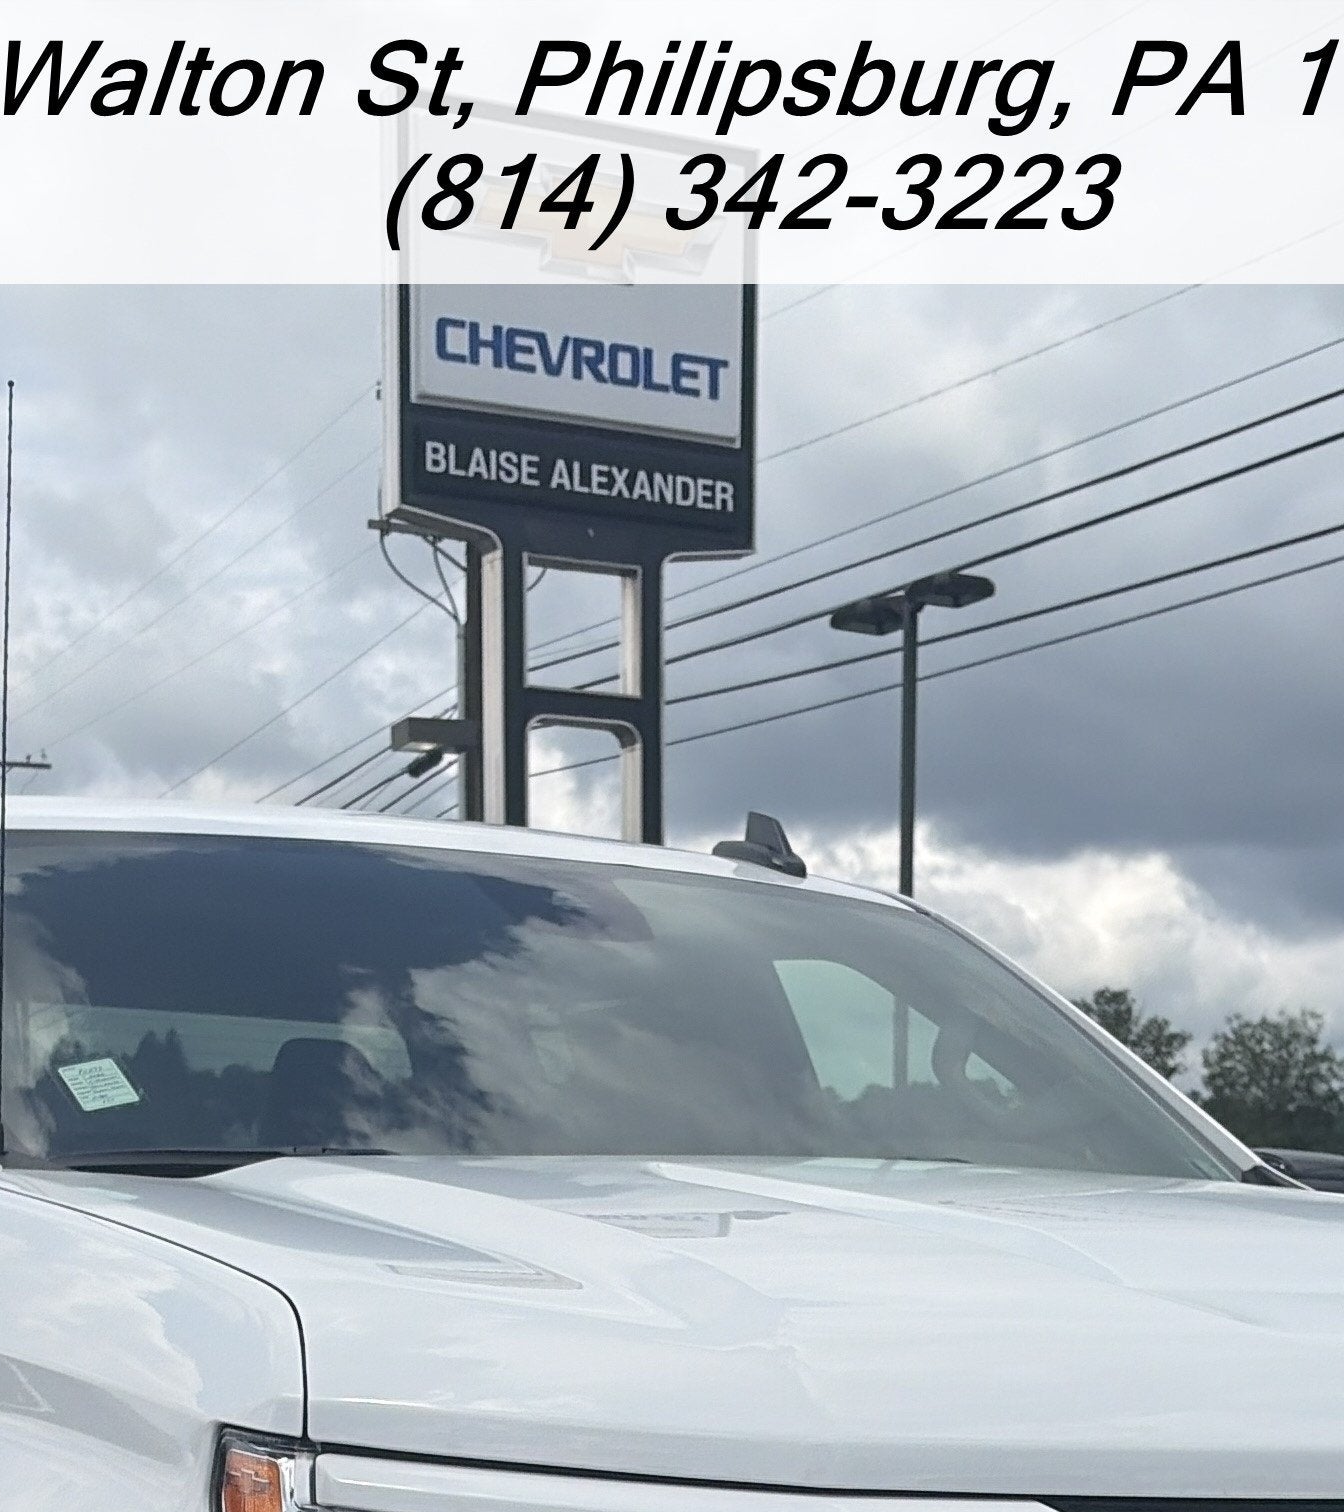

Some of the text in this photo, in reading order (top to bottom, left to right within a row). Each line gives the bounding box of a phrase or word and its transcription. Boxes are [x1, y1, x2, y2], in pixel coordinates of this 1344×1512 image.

[435, 316, 729, 402] CHEVROLET
[423, 440, 735, 513] BLAISE ALEXANDER
